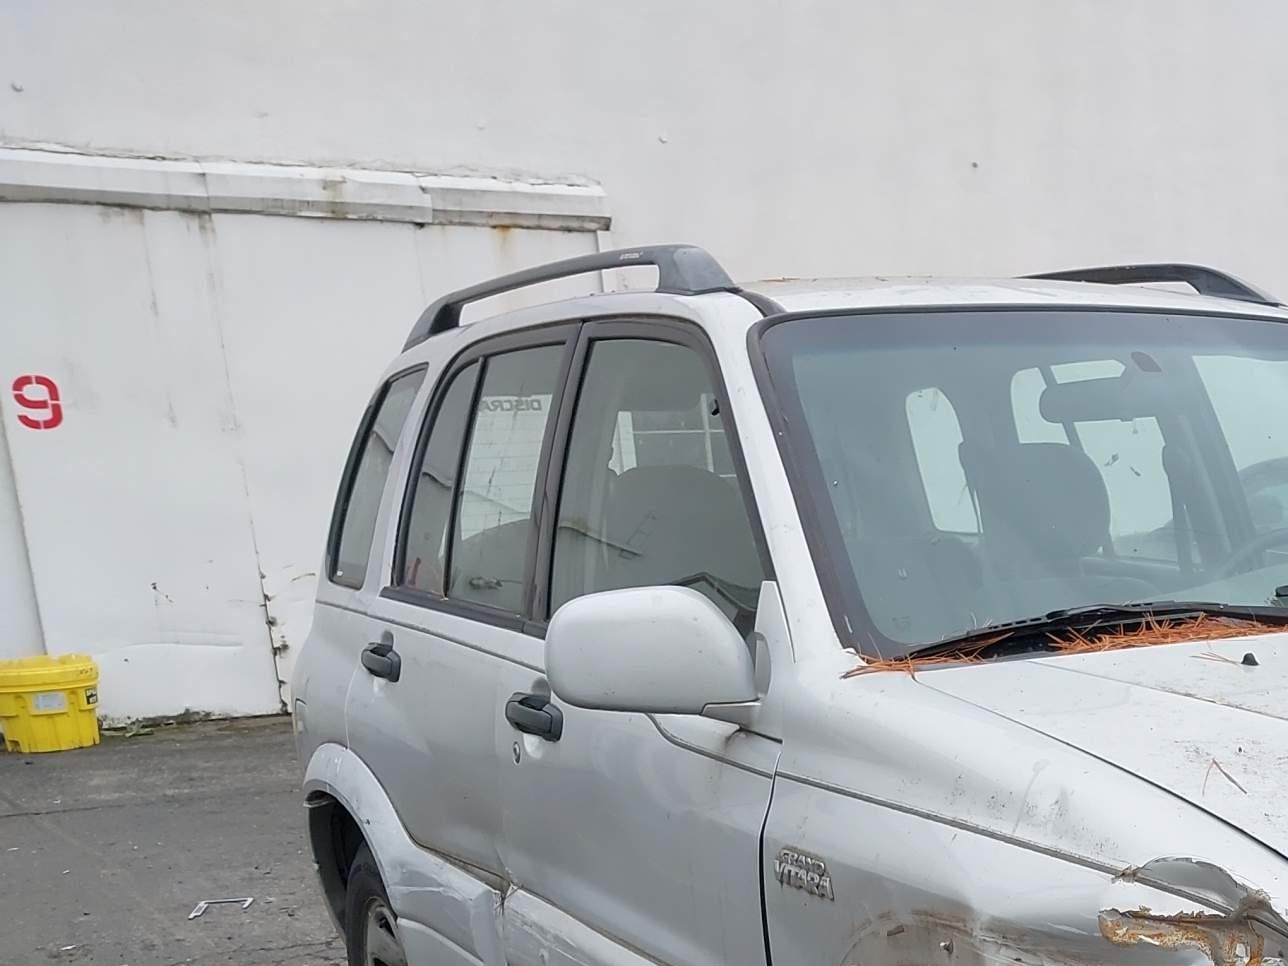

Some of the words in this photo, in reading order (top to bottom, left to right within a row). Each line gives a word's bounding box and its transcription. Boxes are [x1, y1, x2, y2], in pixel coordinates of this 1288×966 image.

[11, 374, 64, 431] 9
[773, 859, 835, 901] VITARA
[779, 849, 825, 876] GRAND
